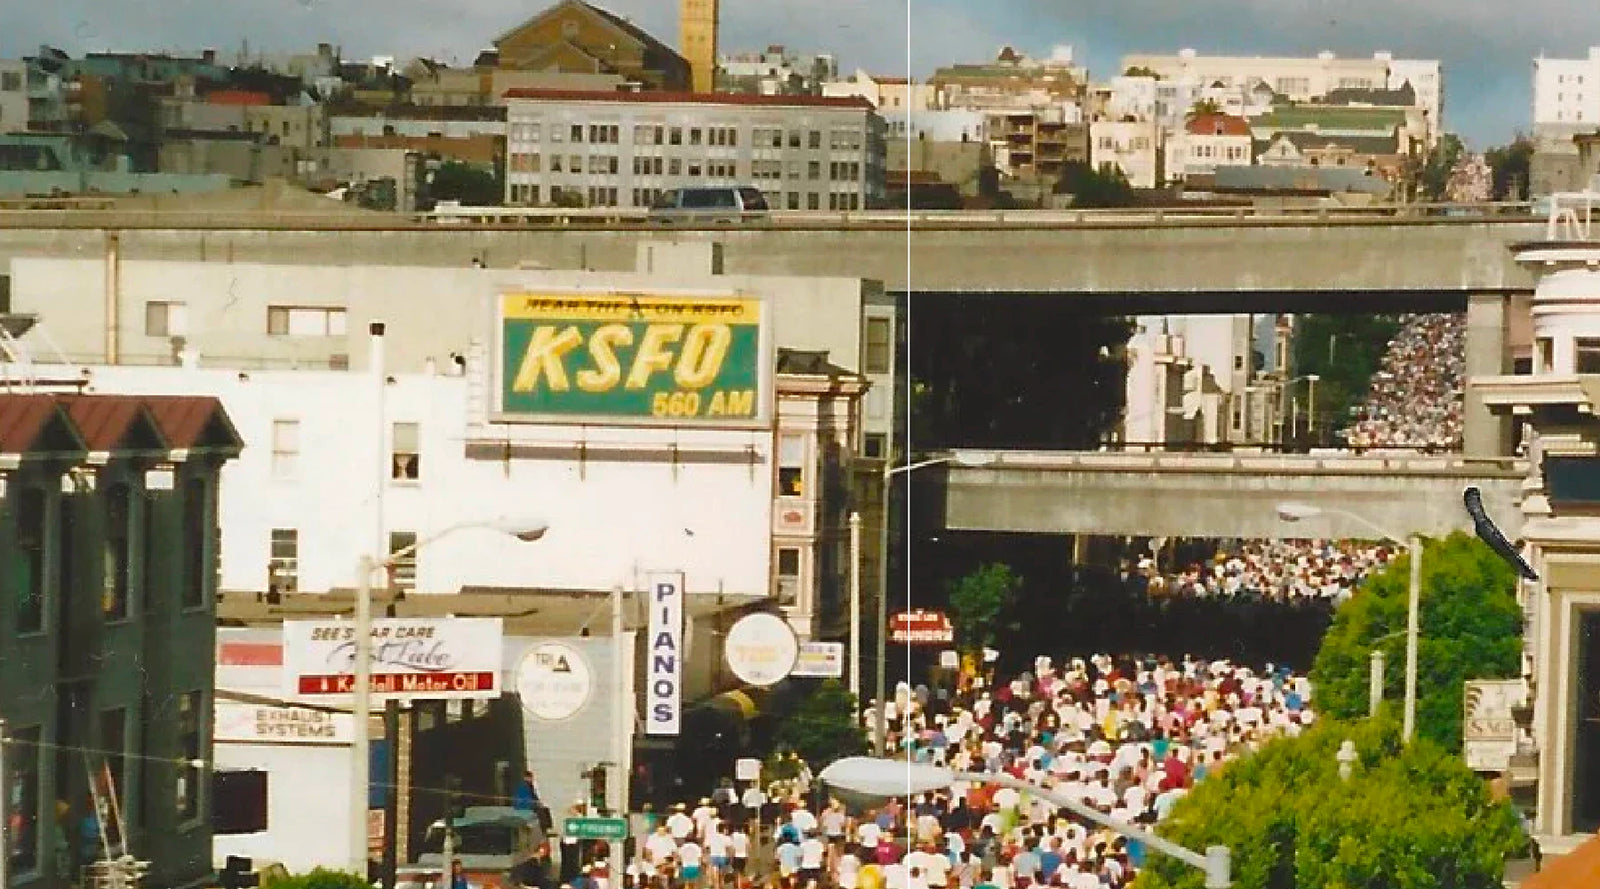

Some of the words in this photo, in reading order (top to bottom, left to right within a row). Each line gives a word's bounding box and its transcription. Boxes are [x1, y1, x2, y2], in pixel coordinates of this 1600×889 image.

[513, 323, 732, 392] KSFO
[653, 392, 700, 417] 560
[708, 390, 754, 415] AM
[369, 627, 390, 639] AR
[395, 627, 436, 639] CARE
[653, 583, 676, 722] PIANOS
[402, 673, 448, 691] Motor
[453, 673, 479, 691] Oil
[256, 710, 333, 723] EXHAUST
[256, 723, 336, 737] SYSTEMS
